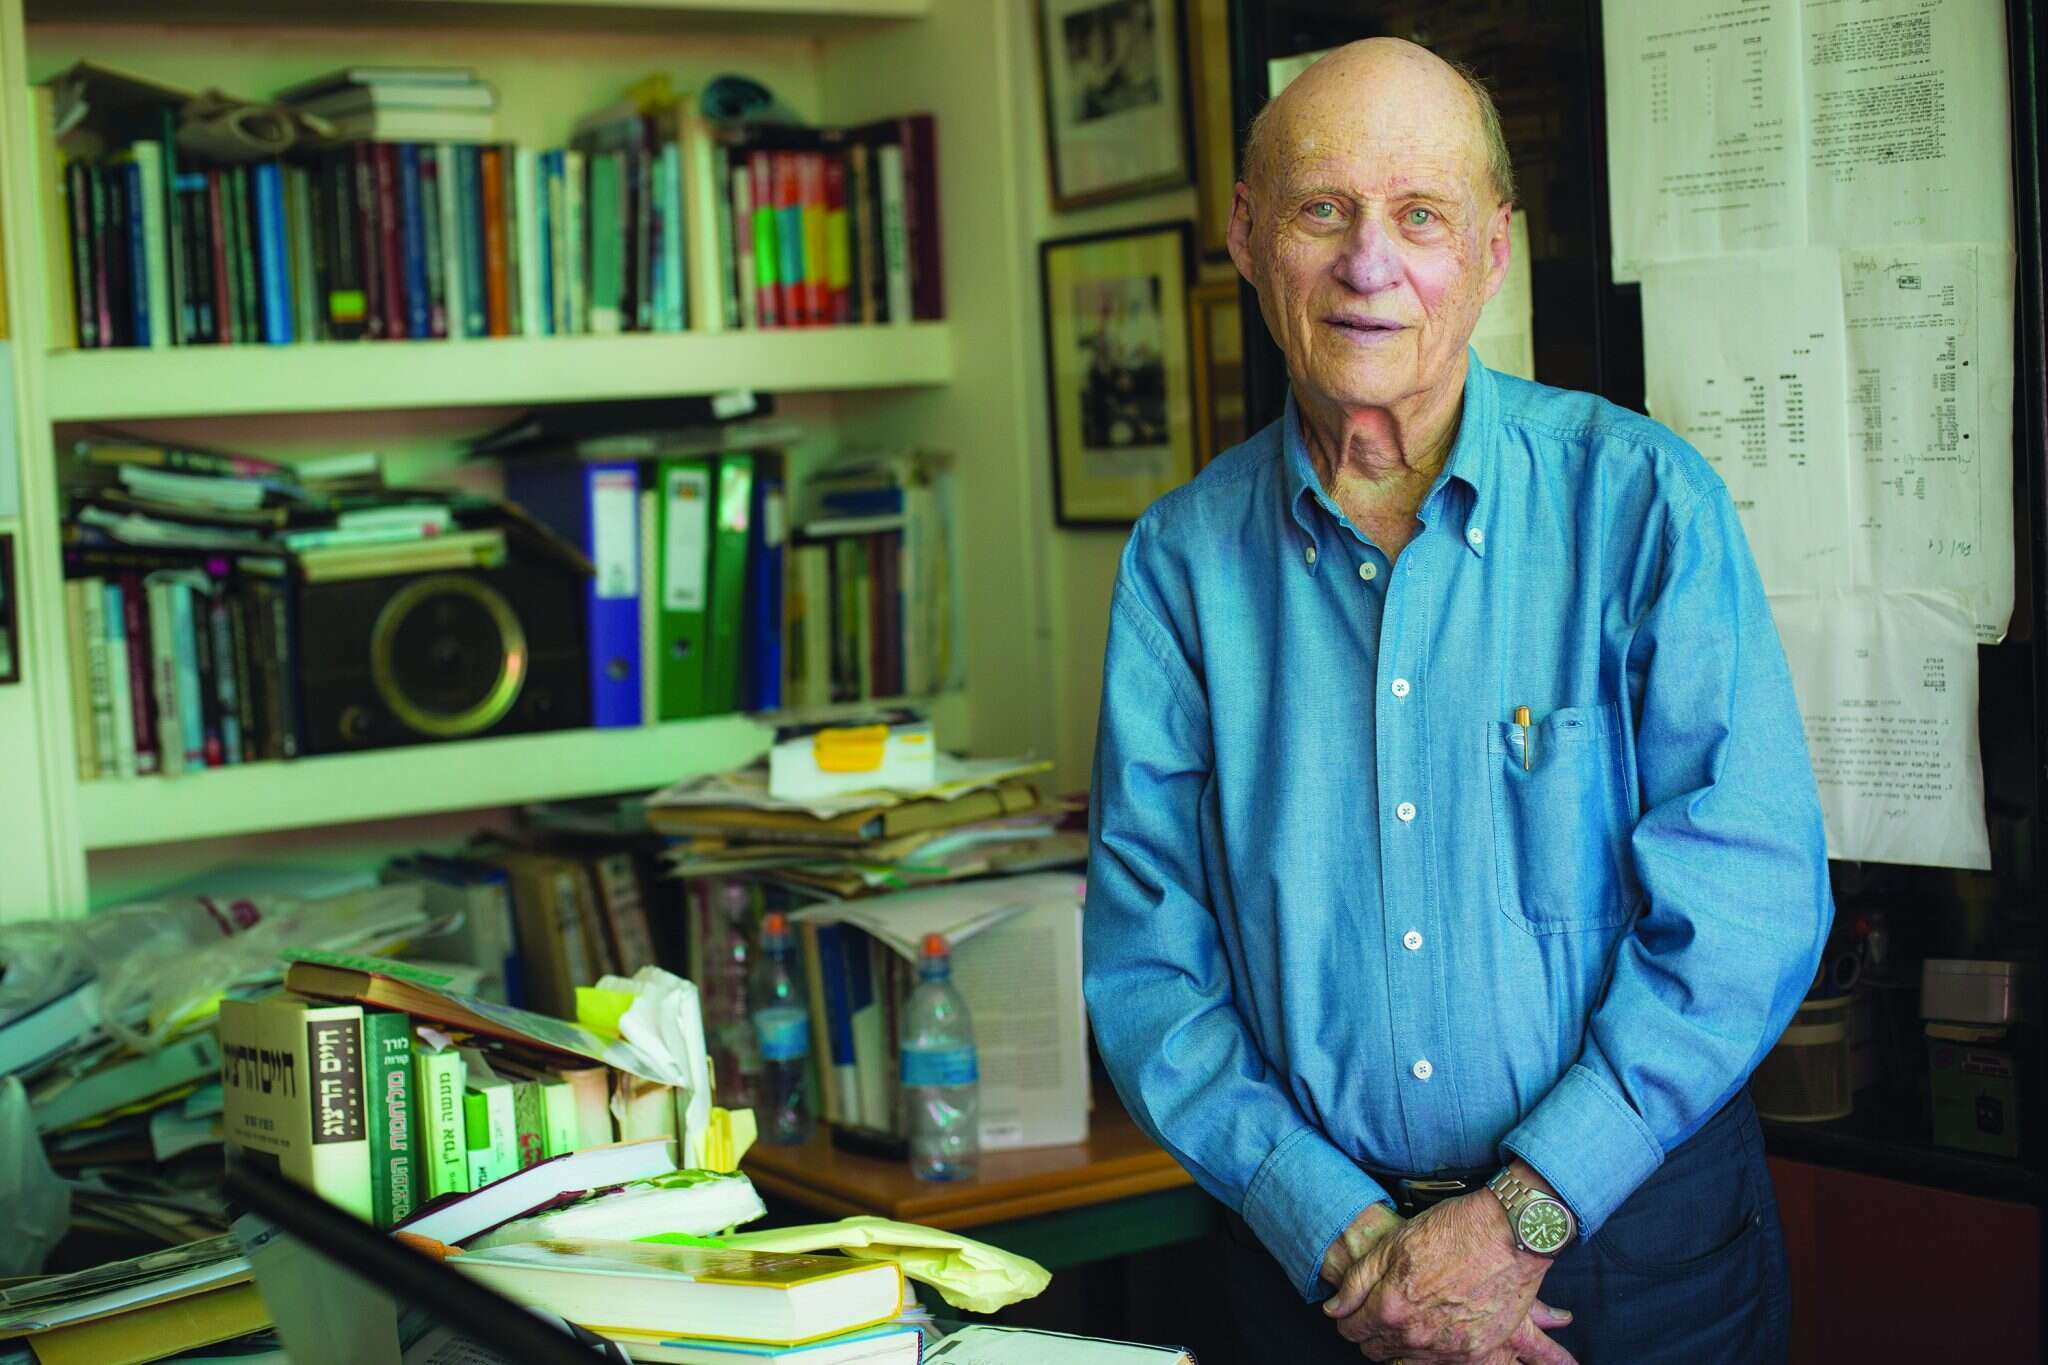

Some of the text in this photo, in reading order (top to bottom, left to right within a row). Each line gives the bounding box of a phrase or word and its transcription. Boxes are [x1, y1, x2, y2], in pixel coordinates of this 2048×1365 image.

[383, 1036, 409, 1053] לורך
[260, 1048, 296, 1098] חיים
[318, 1029, 345, 1136] חיים הרצוג
[440, 1071, 454, 1122] מעשה
[385, 1071, 410, 1223] מלחמת העצמ
